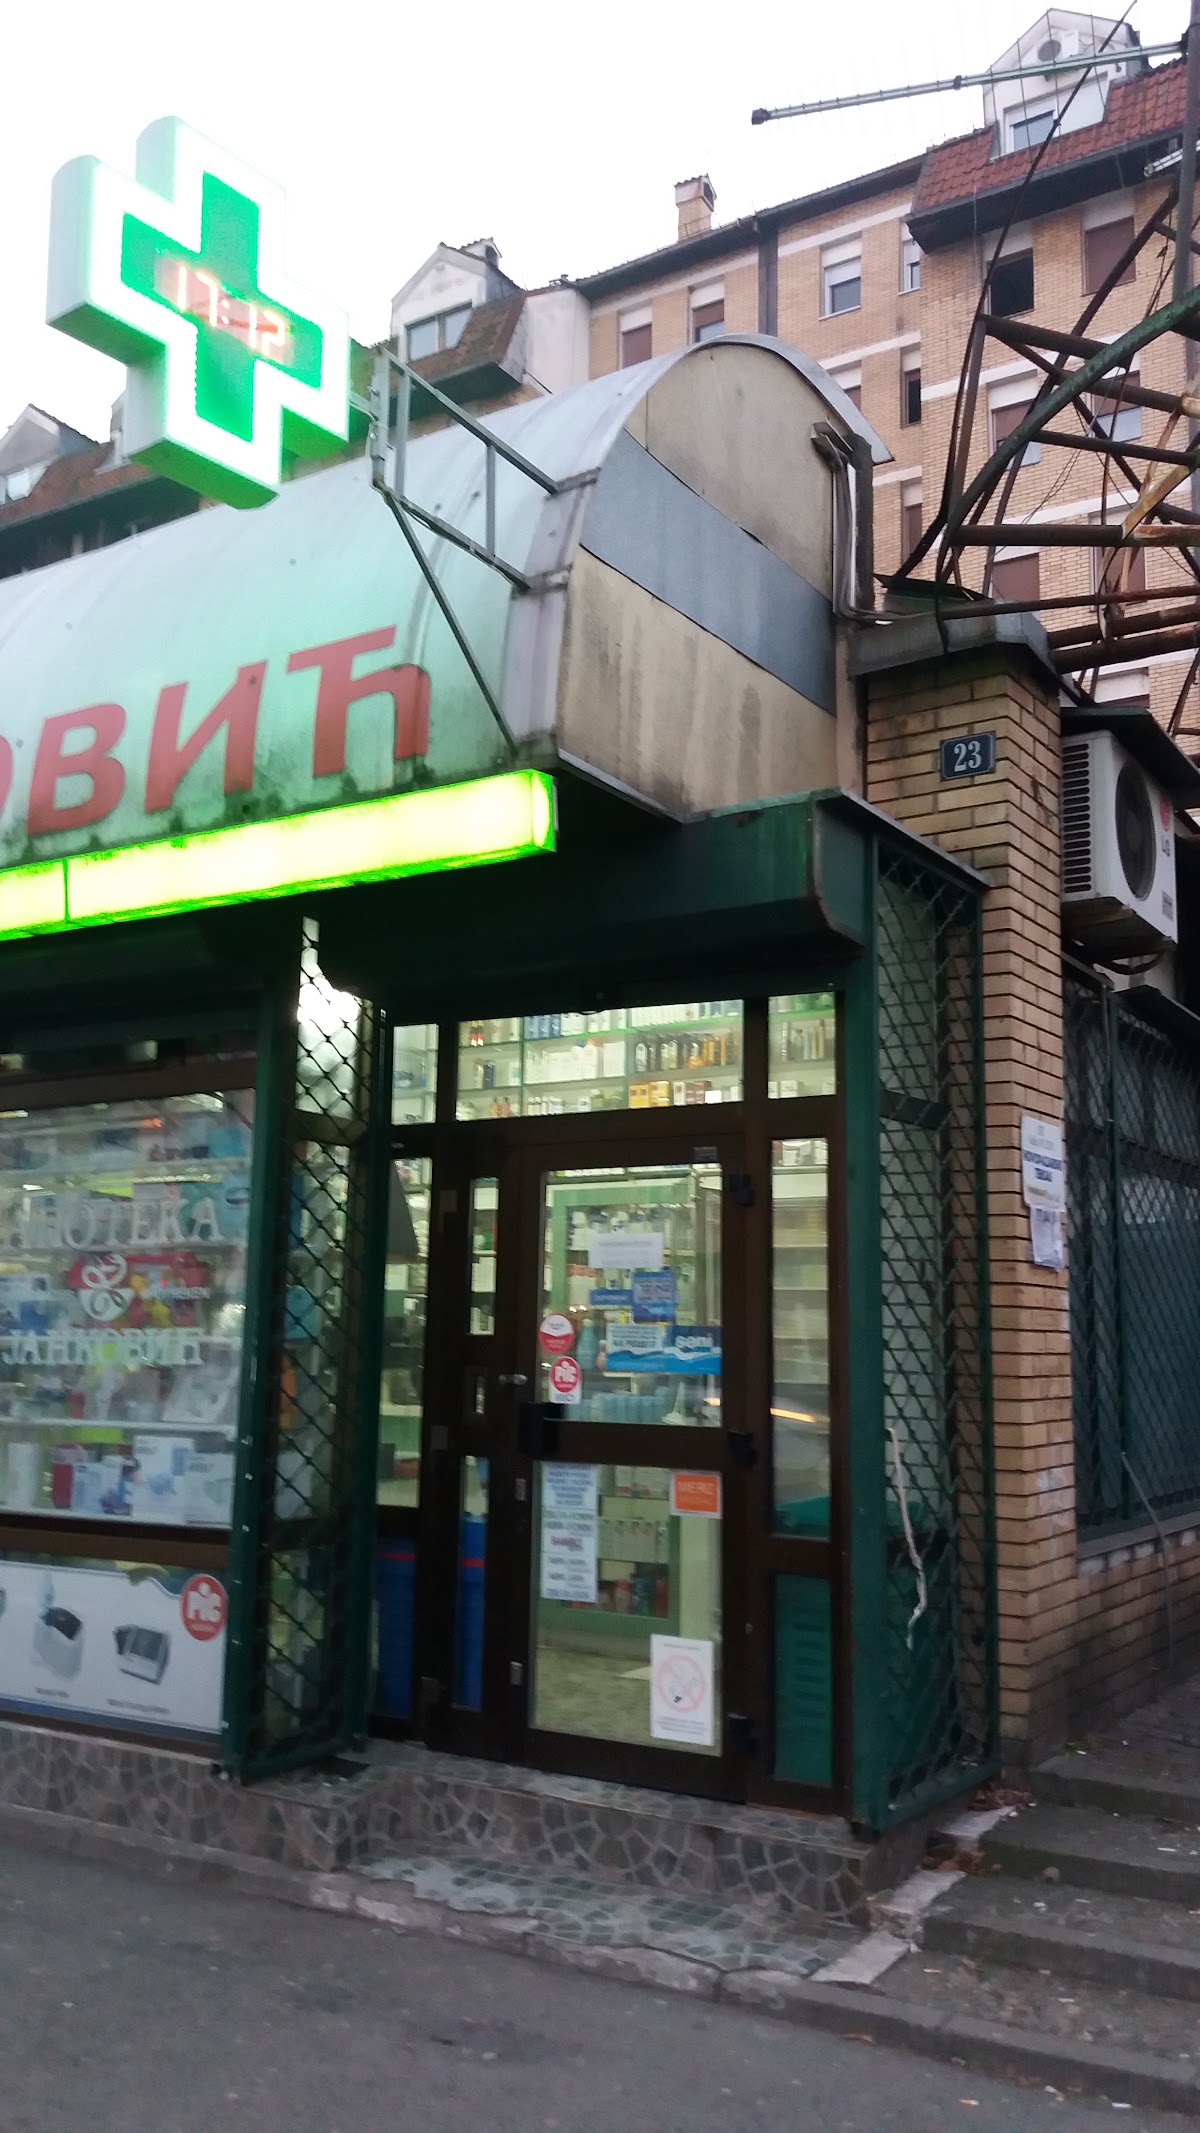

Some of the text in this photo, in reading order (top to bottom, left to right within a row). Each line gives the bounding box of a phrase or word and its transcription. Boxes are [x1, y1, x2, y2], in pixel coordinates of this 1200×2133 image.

[176, 264, 286, 357] 17:12
[0, 624, 431, 837] ВИЋ
[953, 740, 982, 772] 23
[674, 1332, 714, 1349] seni
